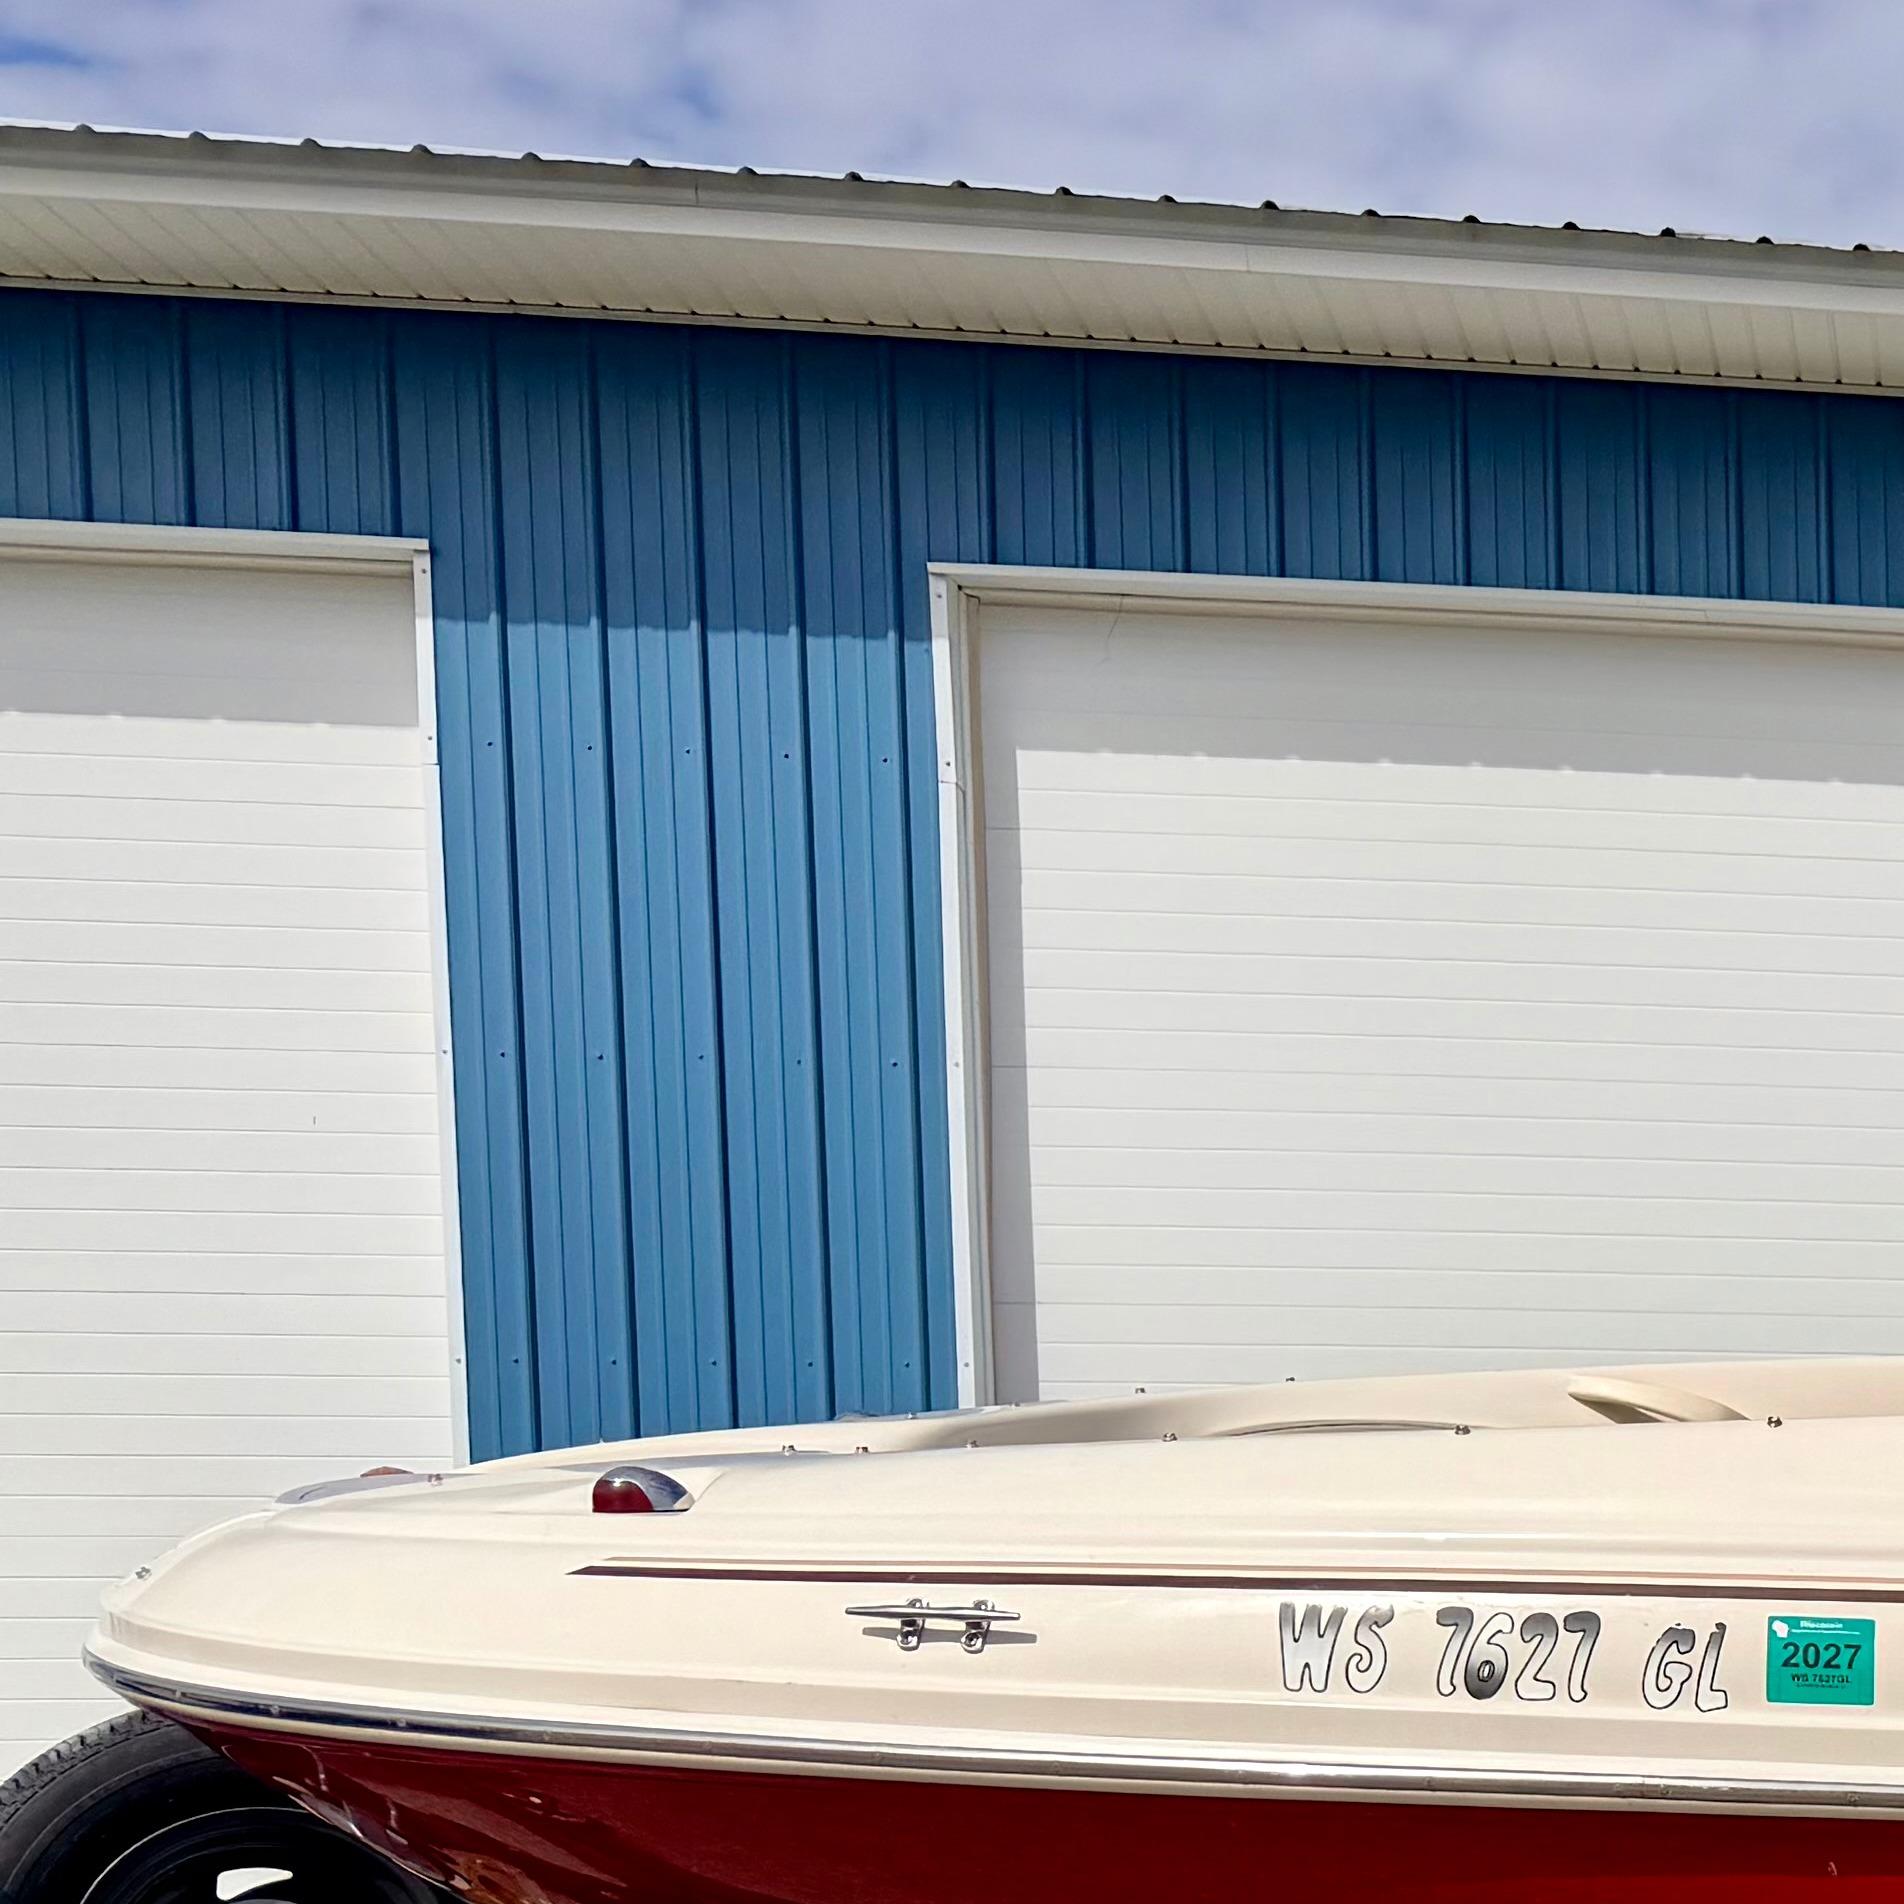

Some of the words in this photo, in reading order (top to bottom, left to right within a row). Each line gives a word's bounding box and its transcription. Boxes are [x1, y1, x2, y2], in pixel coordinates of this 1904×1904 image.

[1279, 1601, 1395, 1694] WS
[1436, 1606, 1601, 1702] 7627
[1642, 1622, 1728, 1713] GL
[1781, 1641, 1862, 1670] 2027
